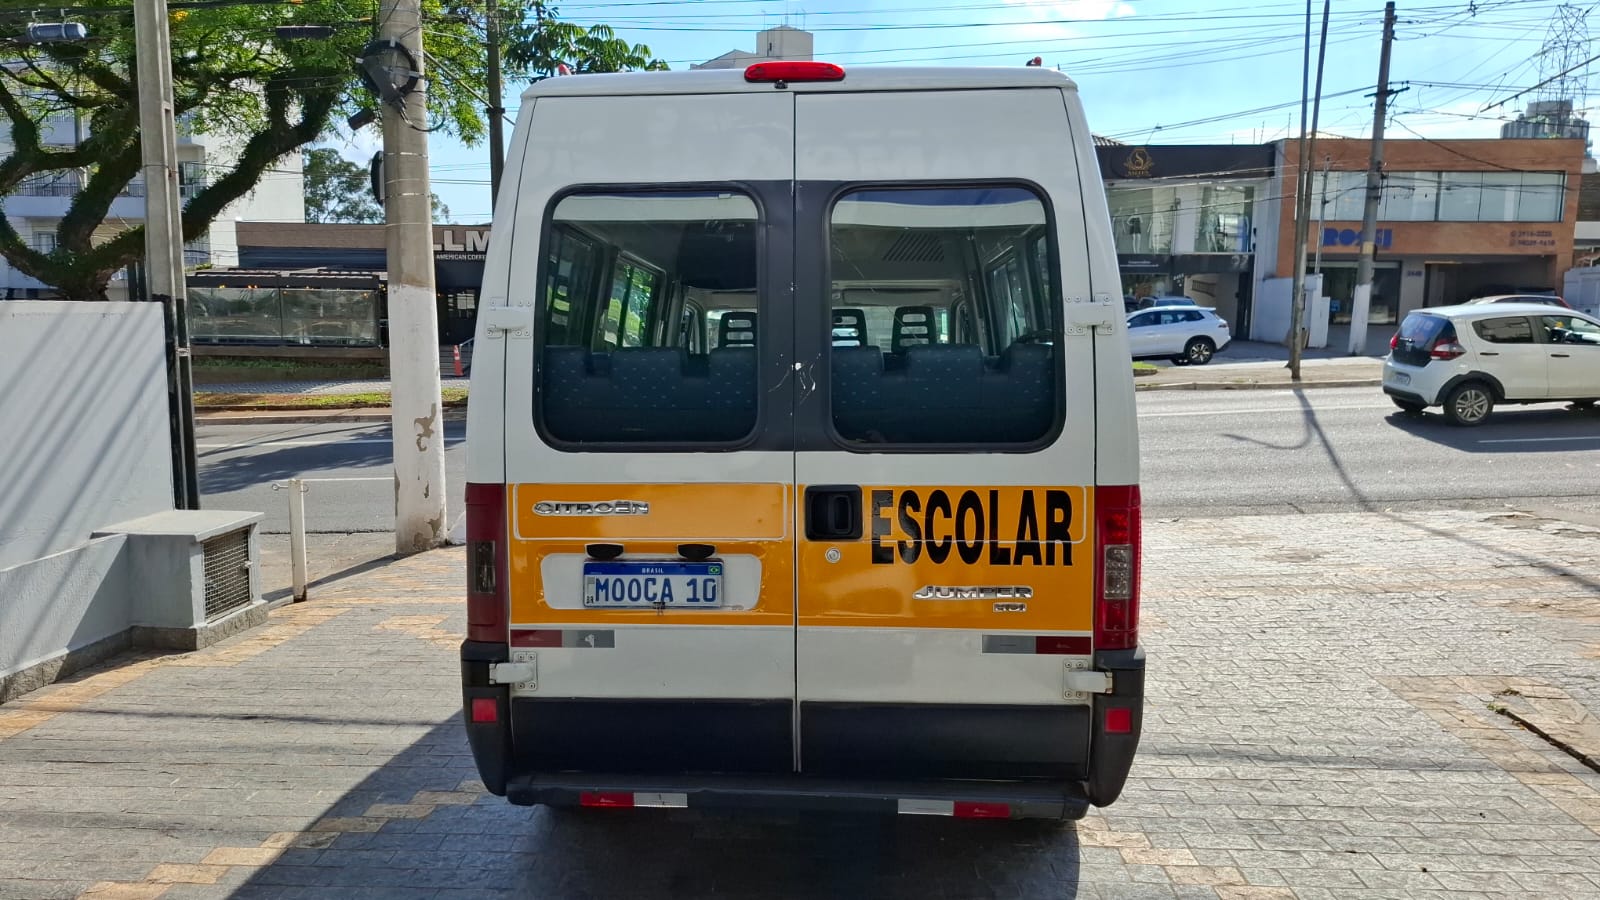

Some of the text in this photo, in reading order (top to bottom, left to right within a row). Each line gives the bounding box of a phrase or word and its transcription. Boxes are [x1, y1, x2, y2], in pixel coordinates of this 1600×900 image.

[533, 500, 650, 516] CITROËN
[871, 489, 1073, 566] ESCOLAR
[595, 577, 717, 603] MOOCA 10
[914, 586, 1033, 599] JUMPER
